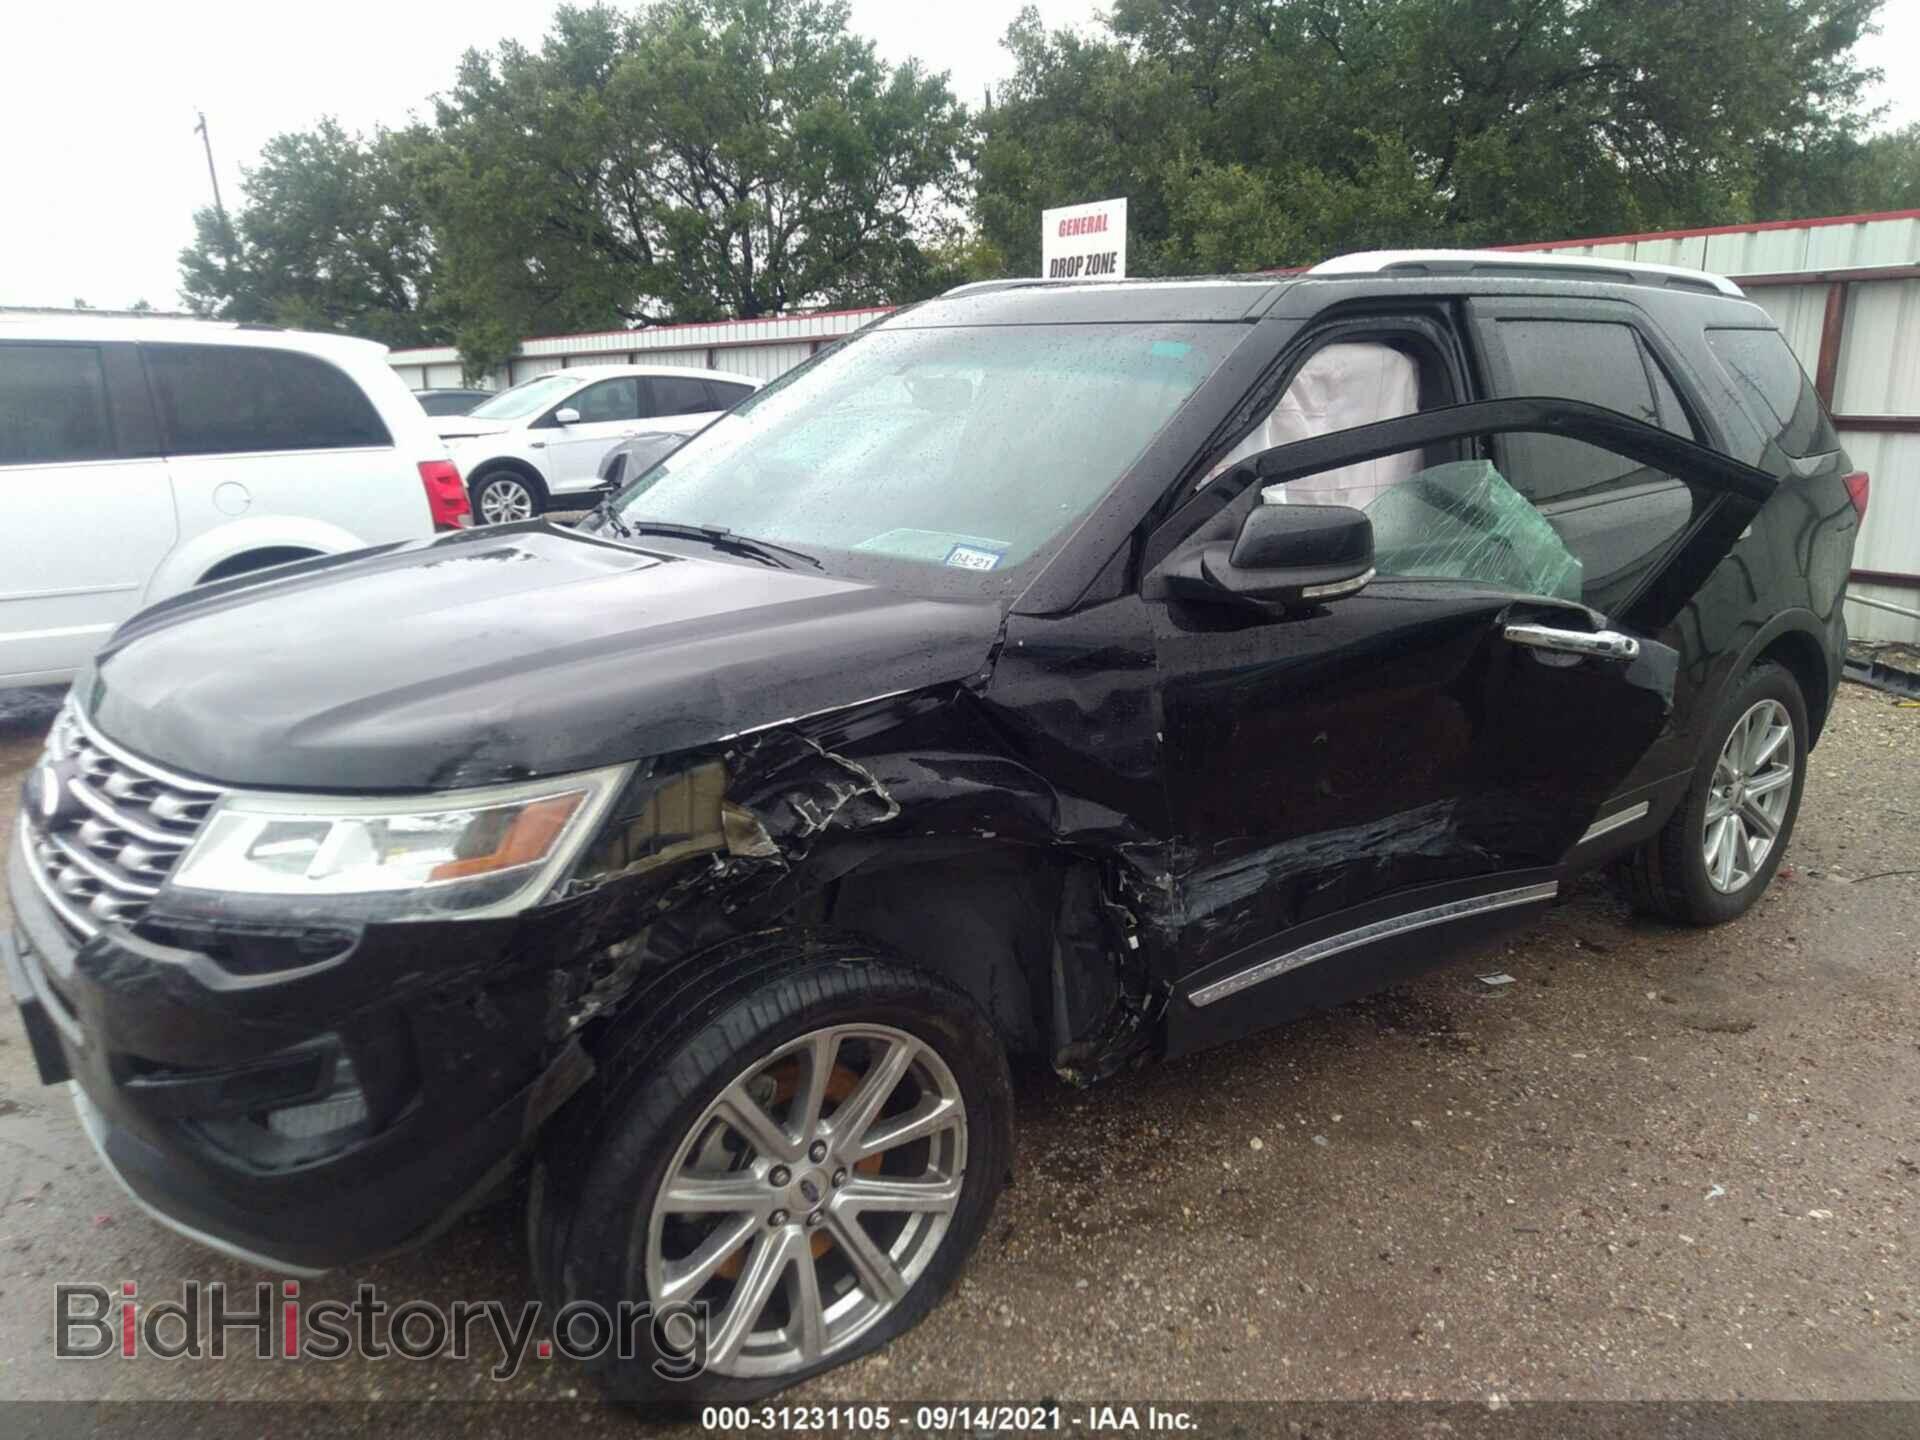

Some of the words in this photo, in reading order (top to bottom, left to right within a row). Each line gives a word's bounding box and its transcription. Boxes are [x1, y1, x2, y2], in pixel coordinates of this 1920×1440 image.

[1058, 214, 1108, 237] GENERAL
[1050, 256, 1084, 278] DROP
[1084, 251, 1118, 276] ZONE
[952, 552, 992, 569] 04-21
